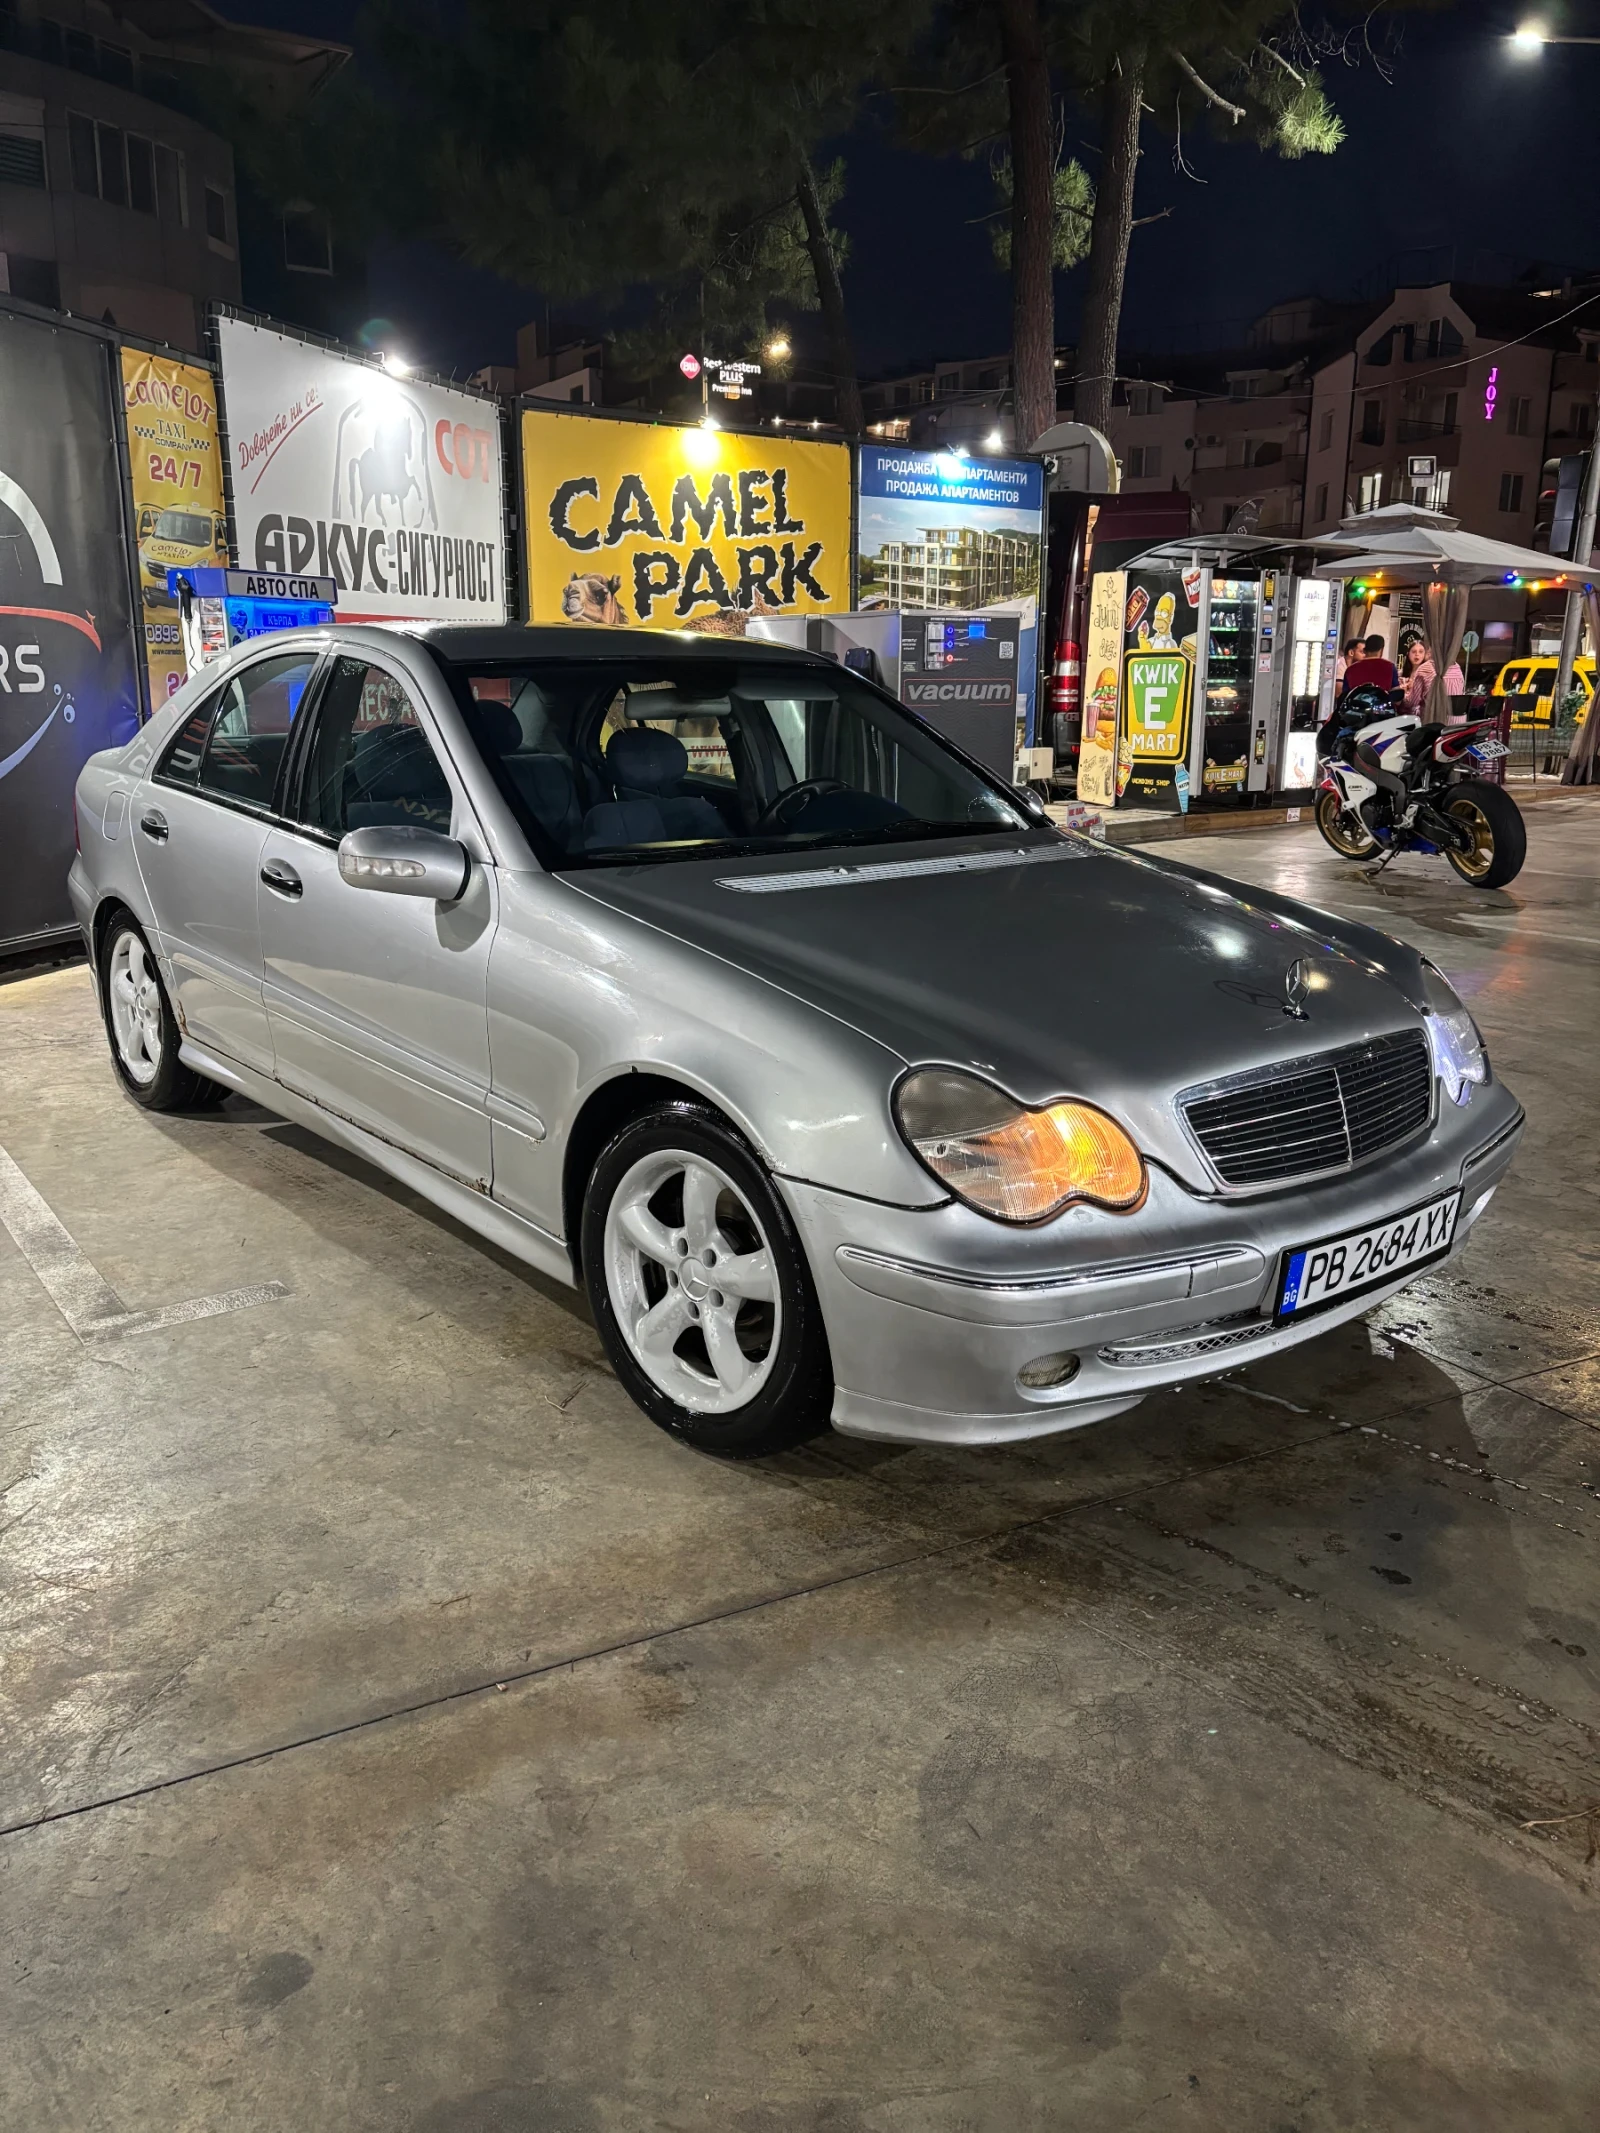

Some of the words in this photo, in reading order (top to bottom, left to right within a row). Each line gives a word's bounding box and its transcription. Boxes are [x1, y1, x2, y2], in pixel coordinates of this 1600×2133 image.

[719, 370, 744, 382] PLUS
[1484, 367, 1498, 420] JOY
[290, 401, 303, 423] ни
[156, 419, 187, 439] TAXI
[154, 437, 193, 452] COMPANY
[435, 419, 493, 483] СОТ
[149, 454, 202, 488] 24/7
[877, 458, 938, 477] ПРОДАЖБА
[956, 465, 1028, 485] ПАРТАМЕНТИ
[886, 480, 939, 496] ПРОДАЖА
[941, 484, 1020, 503] АПАРТАМЕНТОВ
[549, 468, 804, 550] CAMEL
[246, 576, 287, 597] АВТО
[289, 579, 320, 599] СПА
[631, 541, 832, 620] PARK
[267, 615, 293, 627] КЪРПА
[1133, 664, 1179, 685] KWIK
[908, 683, 1011, 701] vacuum
[1144, 687, 1168, 730] E
[1132, 733, 1177, 751] MART
[1303, 1245, 1347, 1300] PB
[1349, 1216, 1421, 1282] 2684
[1418, 1199, 1456, 1253] XX
[1283, 1289, 1297, 1305] BG
